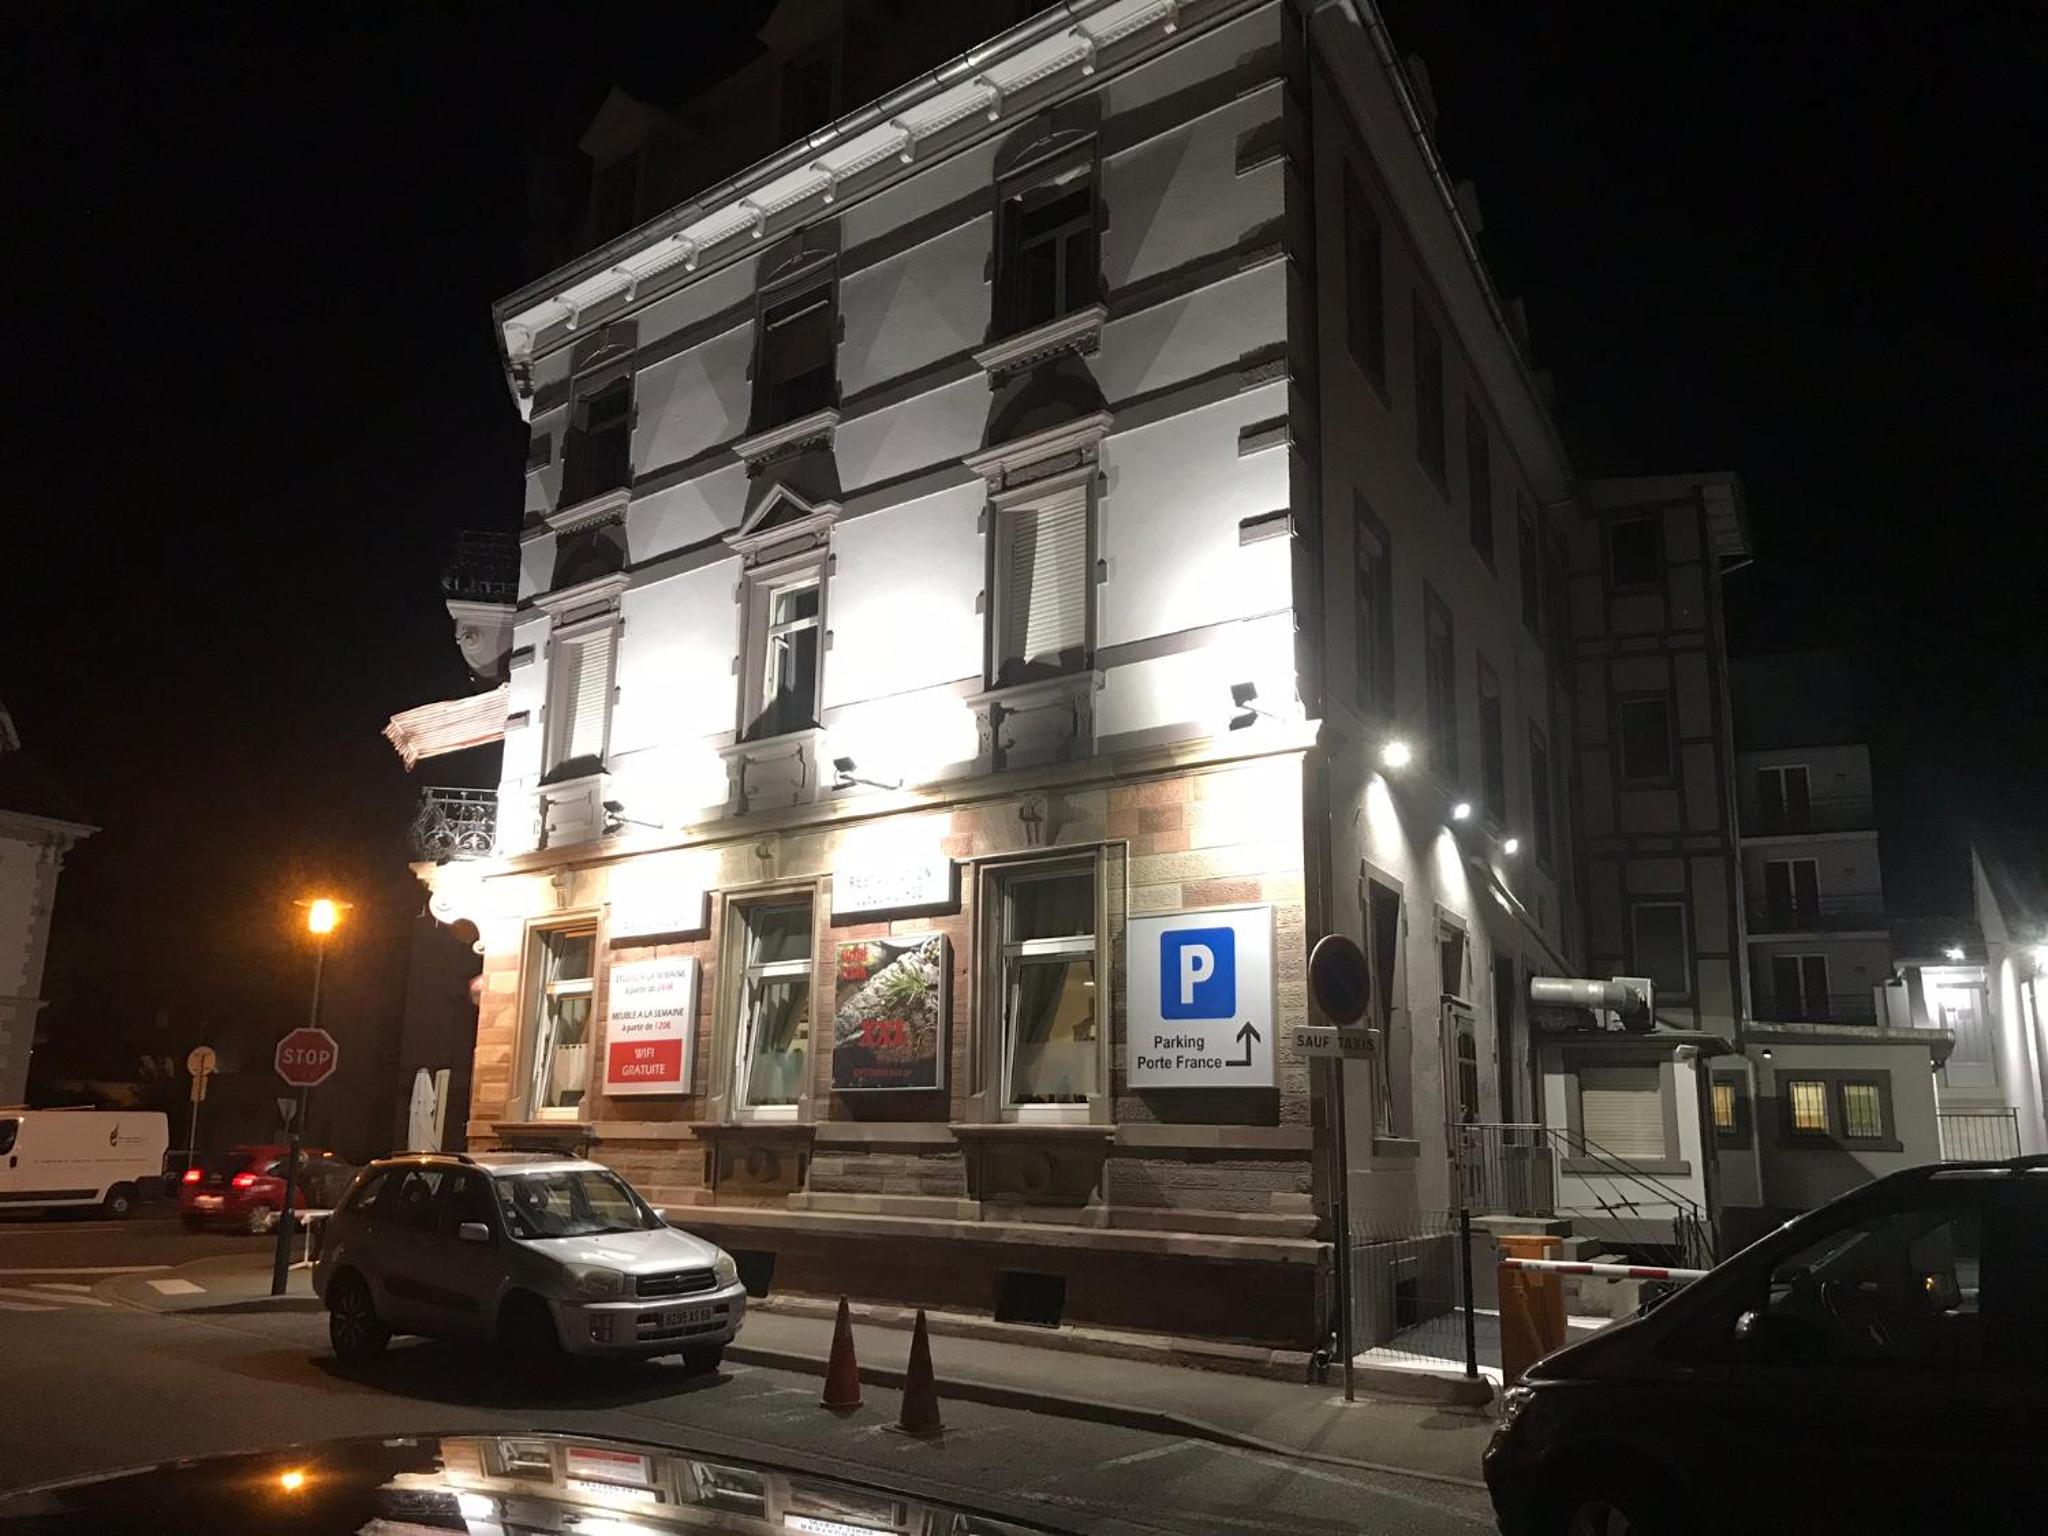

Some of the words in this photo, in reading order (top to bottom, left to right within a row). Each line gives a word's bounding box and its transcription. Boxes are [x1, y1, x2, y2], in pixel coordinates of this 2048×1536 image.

[1179, 944, 1215, 1004] P
[1153, 1035, 1205, 1051] Parking
[1296, 1035, 1330, 1048] SAUF
[1338, 1036, 1375, 1051] TAXIS
[281, 1048, 331, 1066] STOP
[634, 1047, 655, 1059] WIFI
[622, 1063, 667, 1076] GRATUITE
[1137, 1056, 1172, 1070] Porte
[1176, 1056, 1222, 1069] France
